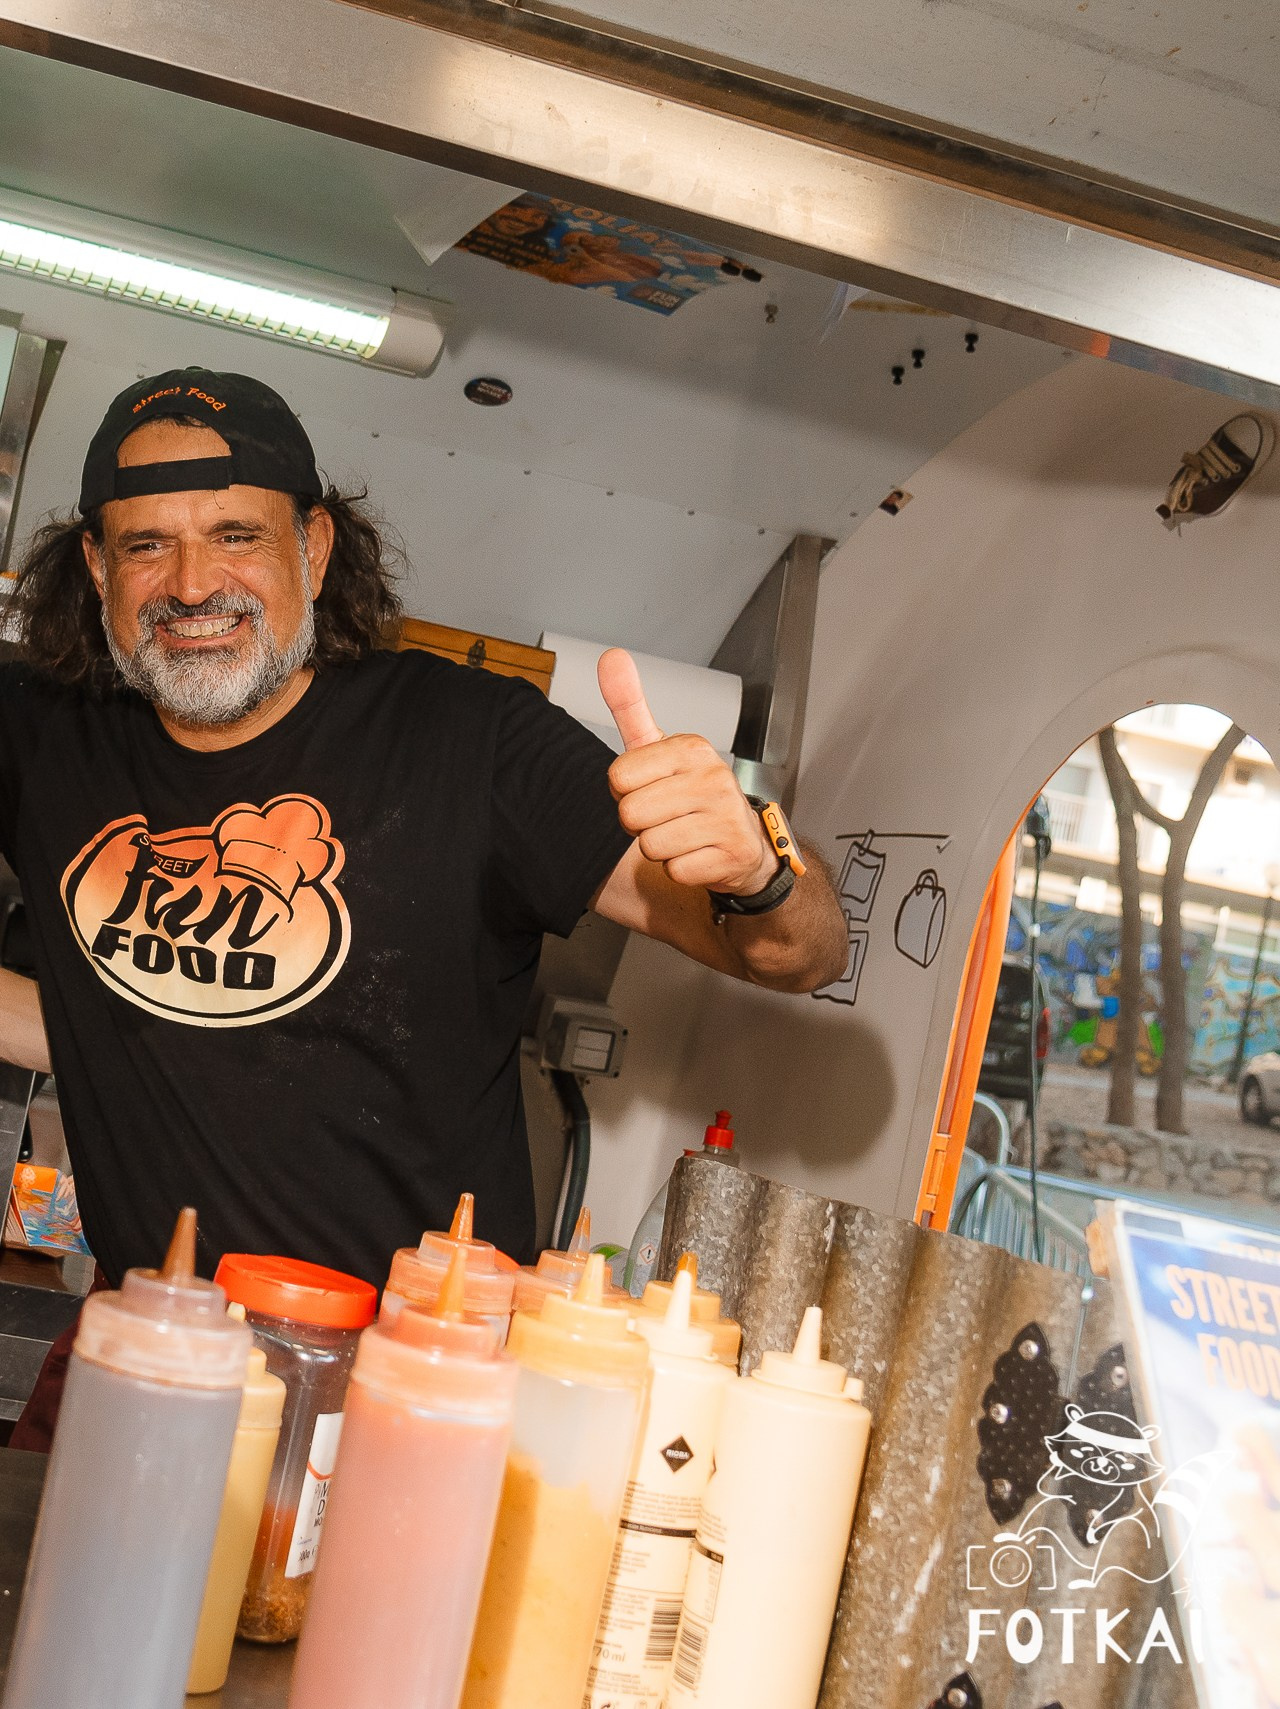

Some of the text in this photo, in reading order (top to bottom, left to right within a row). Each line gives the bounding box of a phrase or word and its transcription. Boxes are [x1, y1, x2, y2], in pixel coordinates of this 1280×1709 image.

[186, 387, 227, 411] Food
[139, 834, 194, 874] SREET
[90, 923, 277, 991] FOOD
